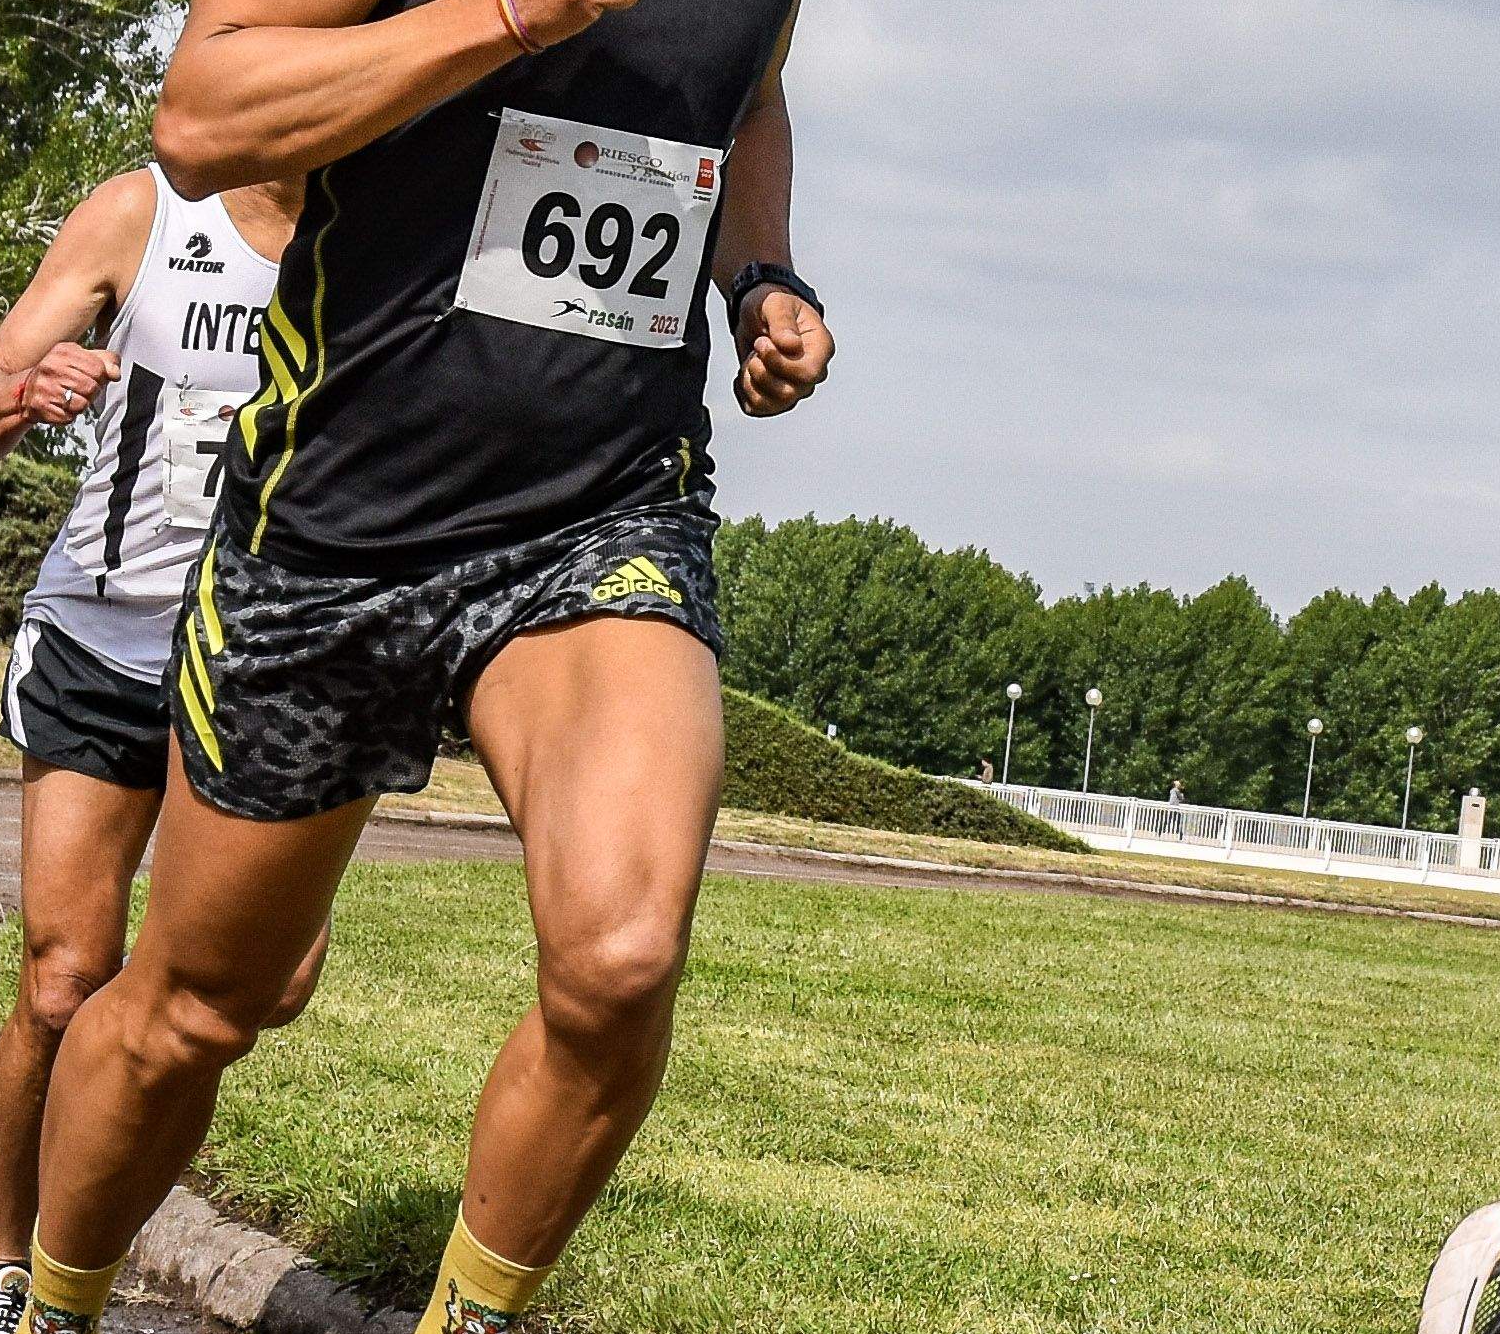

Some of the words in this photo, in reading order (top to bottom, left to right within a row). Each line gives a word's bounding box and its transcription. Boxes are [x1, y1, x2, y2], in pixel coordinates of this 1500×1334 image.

[599, 147, 663, 168] RIESGO
[521, 191, 680, 300] 692
[168, 256, 225, 273] VIATOR
[587, 310, 635, 332] rasán
[649, 314, 680, 335] 2023
[592, 578, 683, 605] adidas
